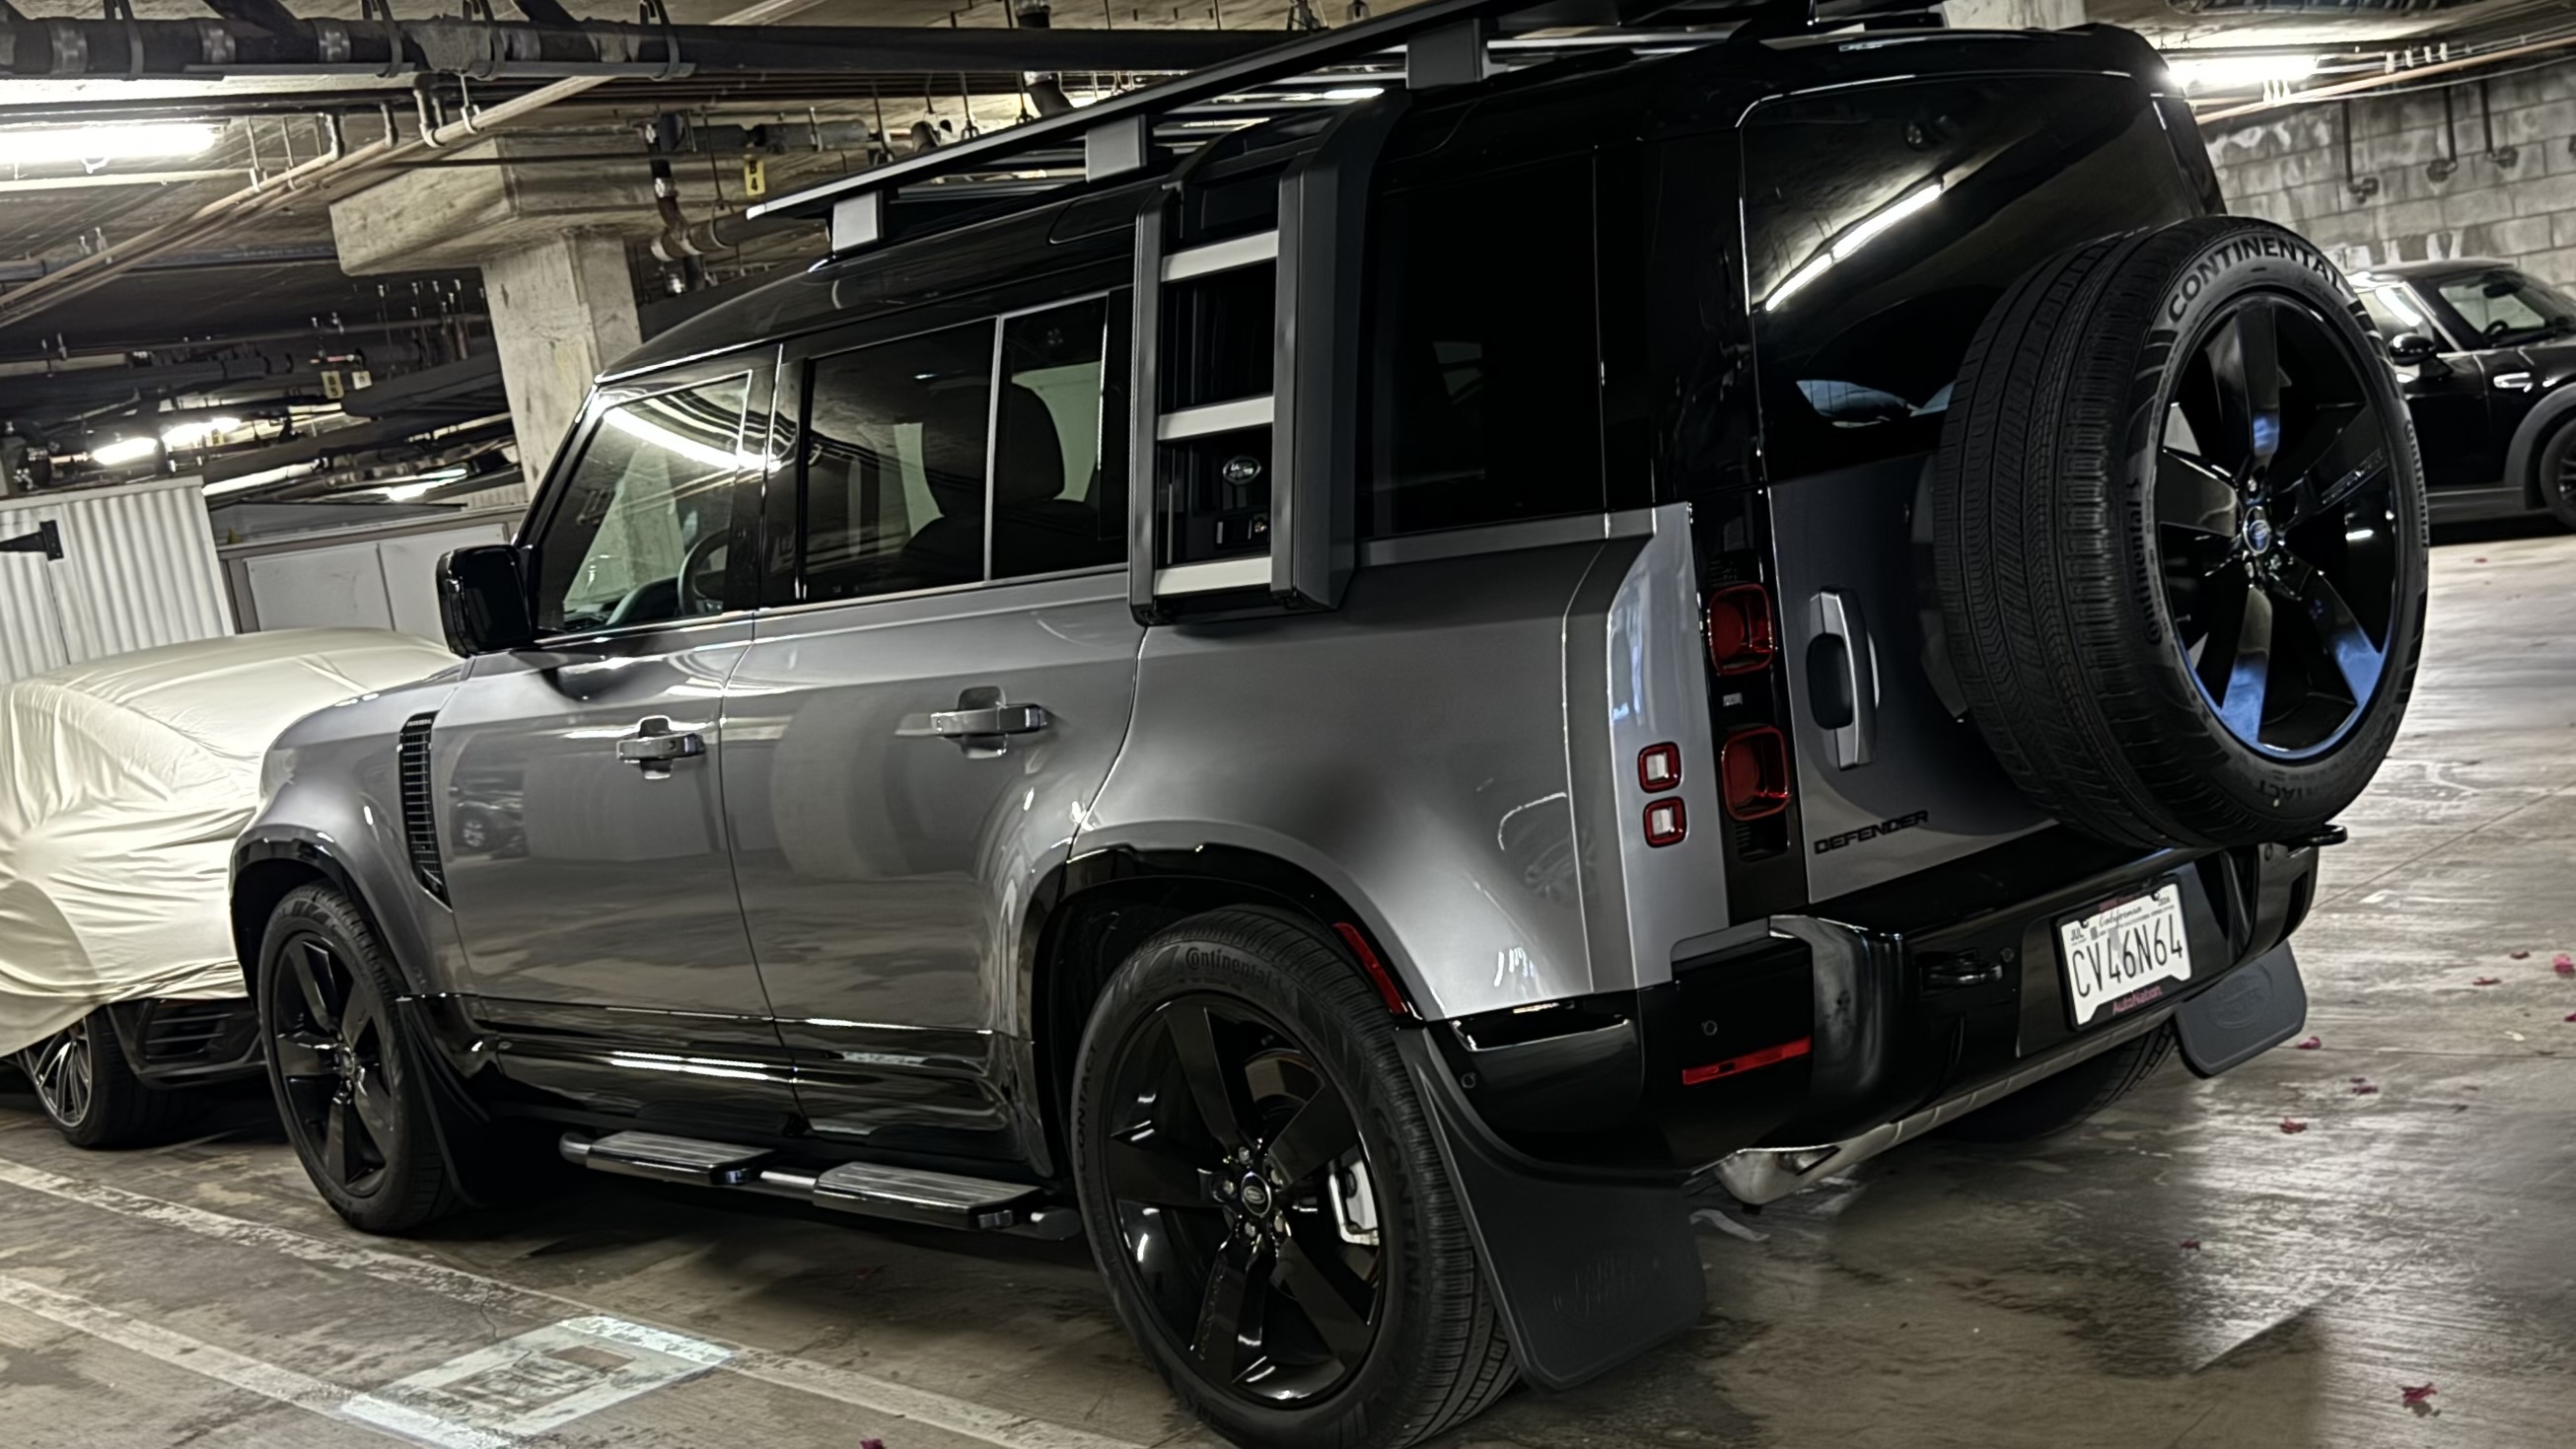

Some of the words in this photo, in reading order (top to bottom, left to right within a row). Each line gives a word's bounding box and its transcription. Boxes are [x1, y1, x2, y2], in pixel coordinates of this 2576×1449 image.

[2168, 235, 2345, 324] CONTINENTAL
[2125, 499, 2163, 645] Continental
[1814, 809, 1929, 855] DEFENDER
[2072, 913, 2182, 997] CV46N64
